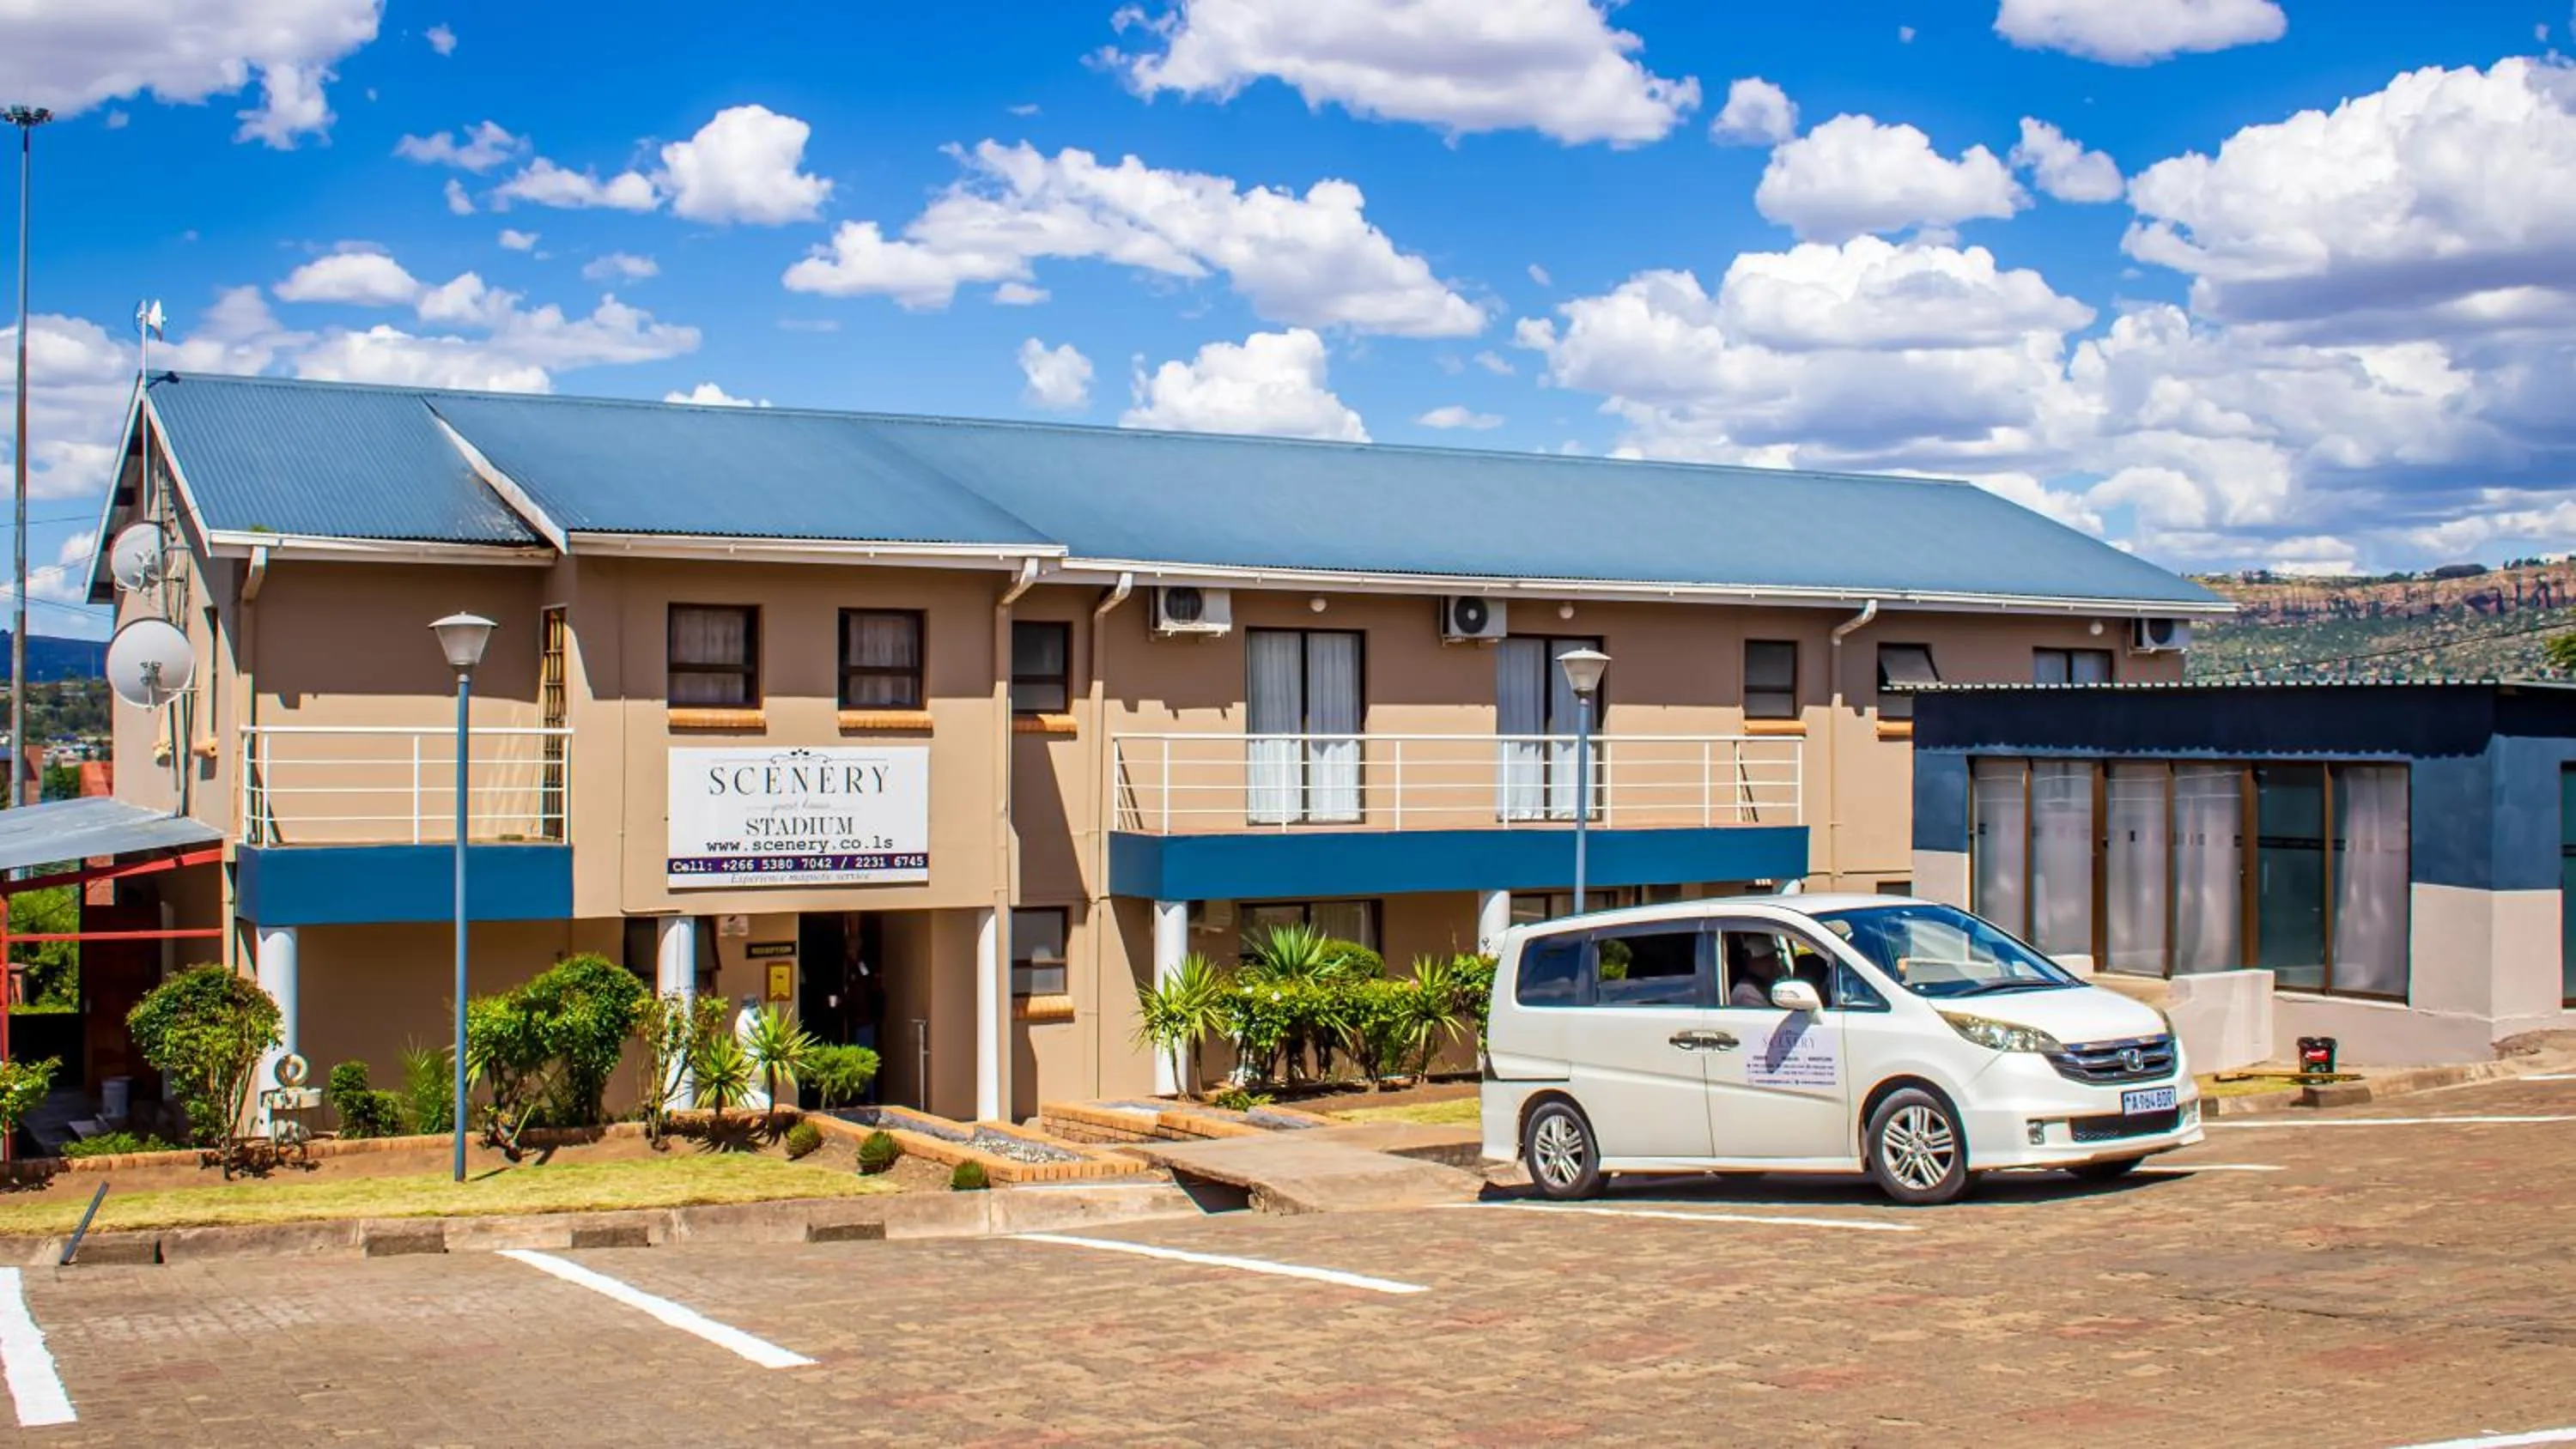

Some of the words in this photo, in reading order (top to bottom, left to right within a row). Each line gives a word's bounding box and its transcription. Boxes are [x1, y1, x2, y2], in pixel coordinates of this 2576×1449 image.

[709, 767, 890, 796] SCENERY
[745, 816, 854, 837] STADIUM
[706, 835, 894, 853] www.scenery.co.ls
[720, 859, 755, 871] +266
[762, 858, 793, 870] 5380
[801, 857, 832, 870] 7042
[839, 856, 848, 870] /
[854, 856, 886, 869] 2231
[893, 855, 925, 868] 6745
